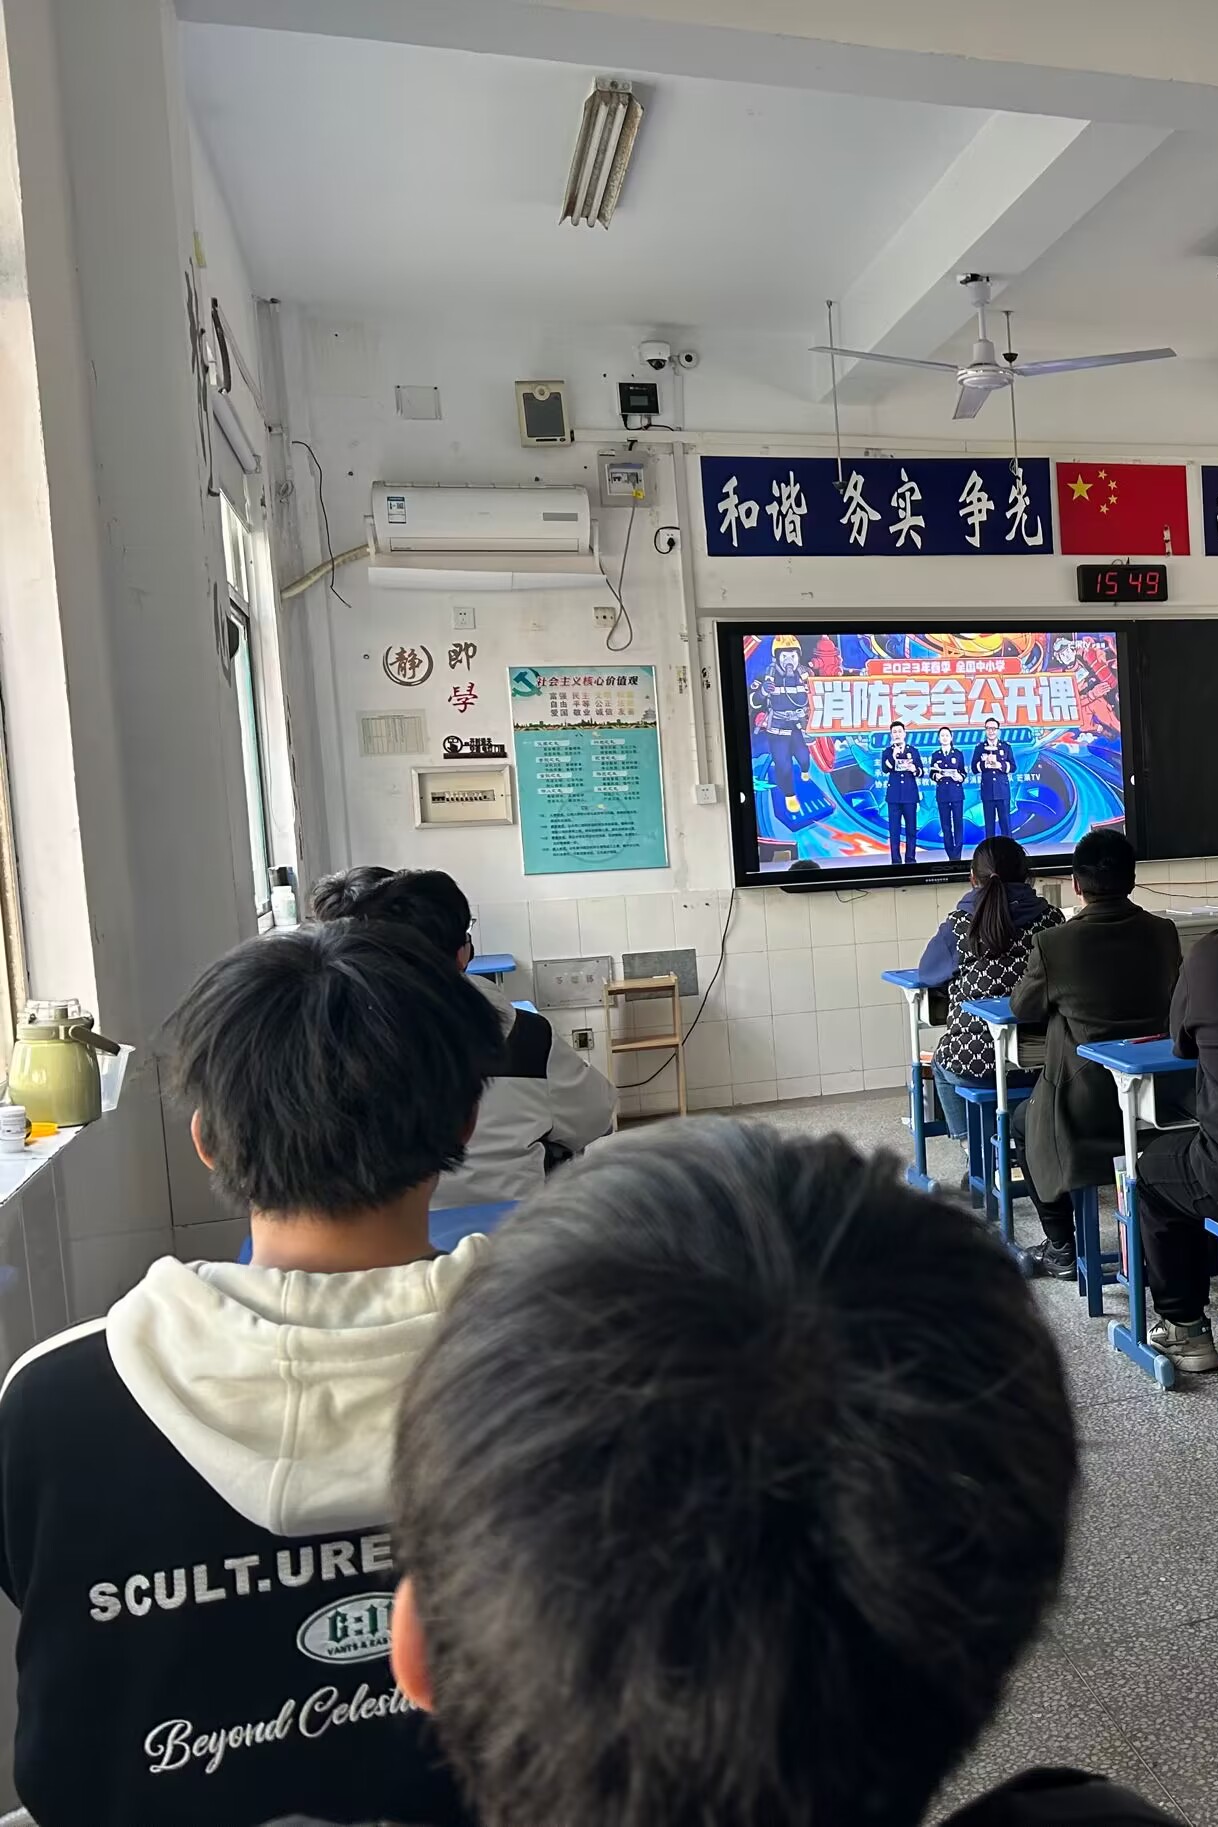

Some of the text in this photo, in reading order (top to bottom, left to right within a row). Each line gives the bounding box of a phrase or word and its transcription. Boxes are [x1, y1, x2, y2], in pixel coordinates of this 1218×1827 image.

[537, 675, 639, 687] 社会主义核心价值观
[882, 660, 1006, 674] 2023年春季 全国中小学
[811, 677, 1079, 728] 消防安全公开课
[144, 1698, 295, 1774] Beyond
